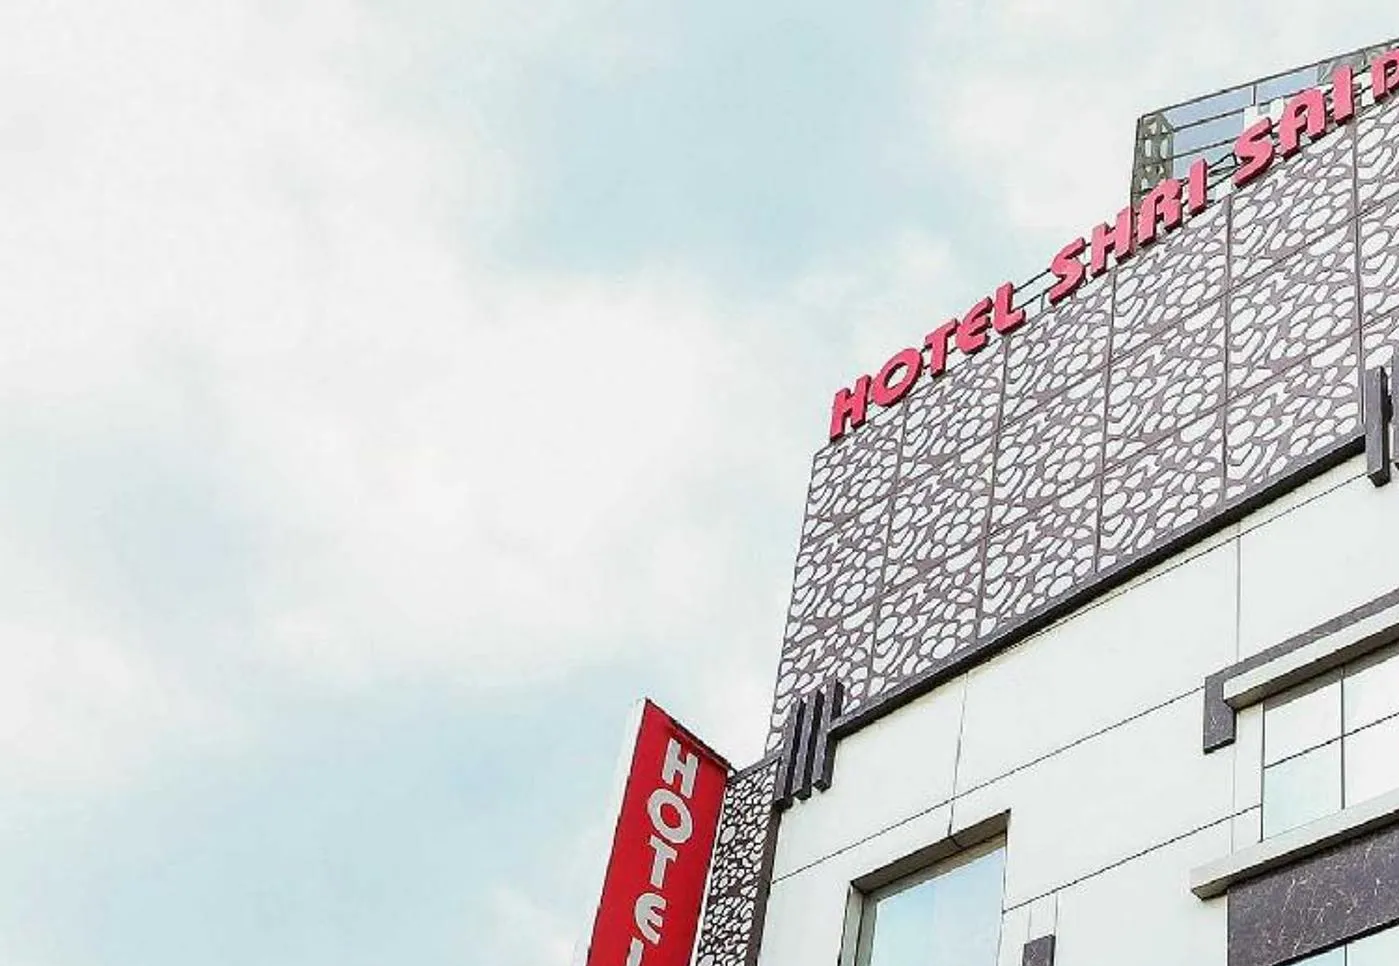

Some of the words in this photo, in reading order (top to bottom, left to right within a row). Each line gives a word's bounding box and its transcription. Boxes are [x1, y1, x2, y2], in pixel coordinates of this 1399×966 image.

[830, 281, 1025, 441] HOTEL
[1049, 158, 1208, 304] SHRI
[1233, 66, 1355, 187] SAI
